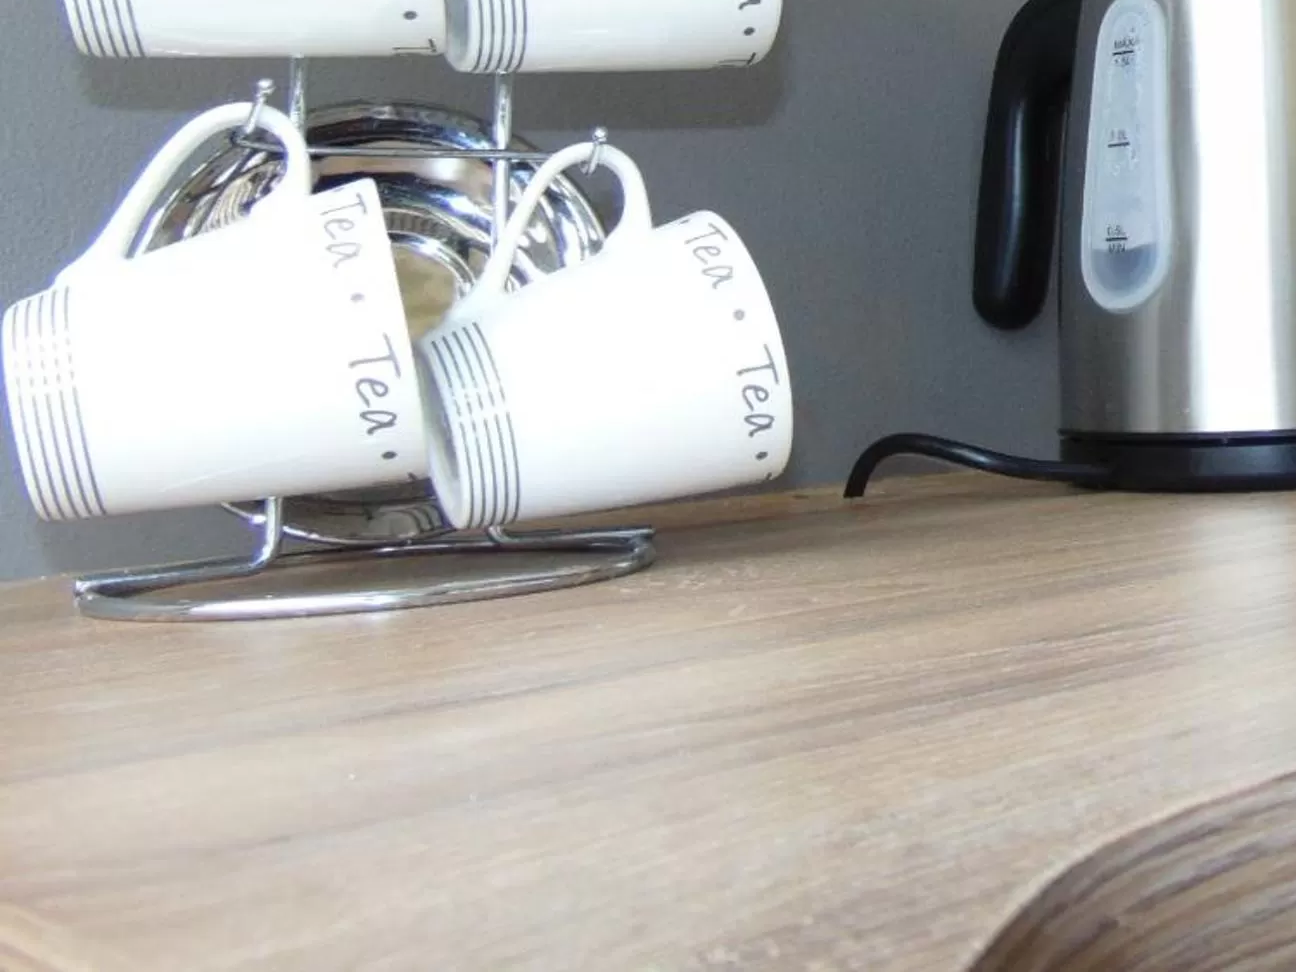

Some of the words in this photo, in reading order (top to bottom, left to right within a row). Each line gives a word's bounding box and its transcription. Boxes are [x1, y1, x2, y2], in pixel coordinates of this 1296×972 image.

[319, 191, 368, 269] Tea
[348, 331, 402, 436] Tea
[683, 221, 735, 290] Tea
[735, 342, 780, 439] Tea
